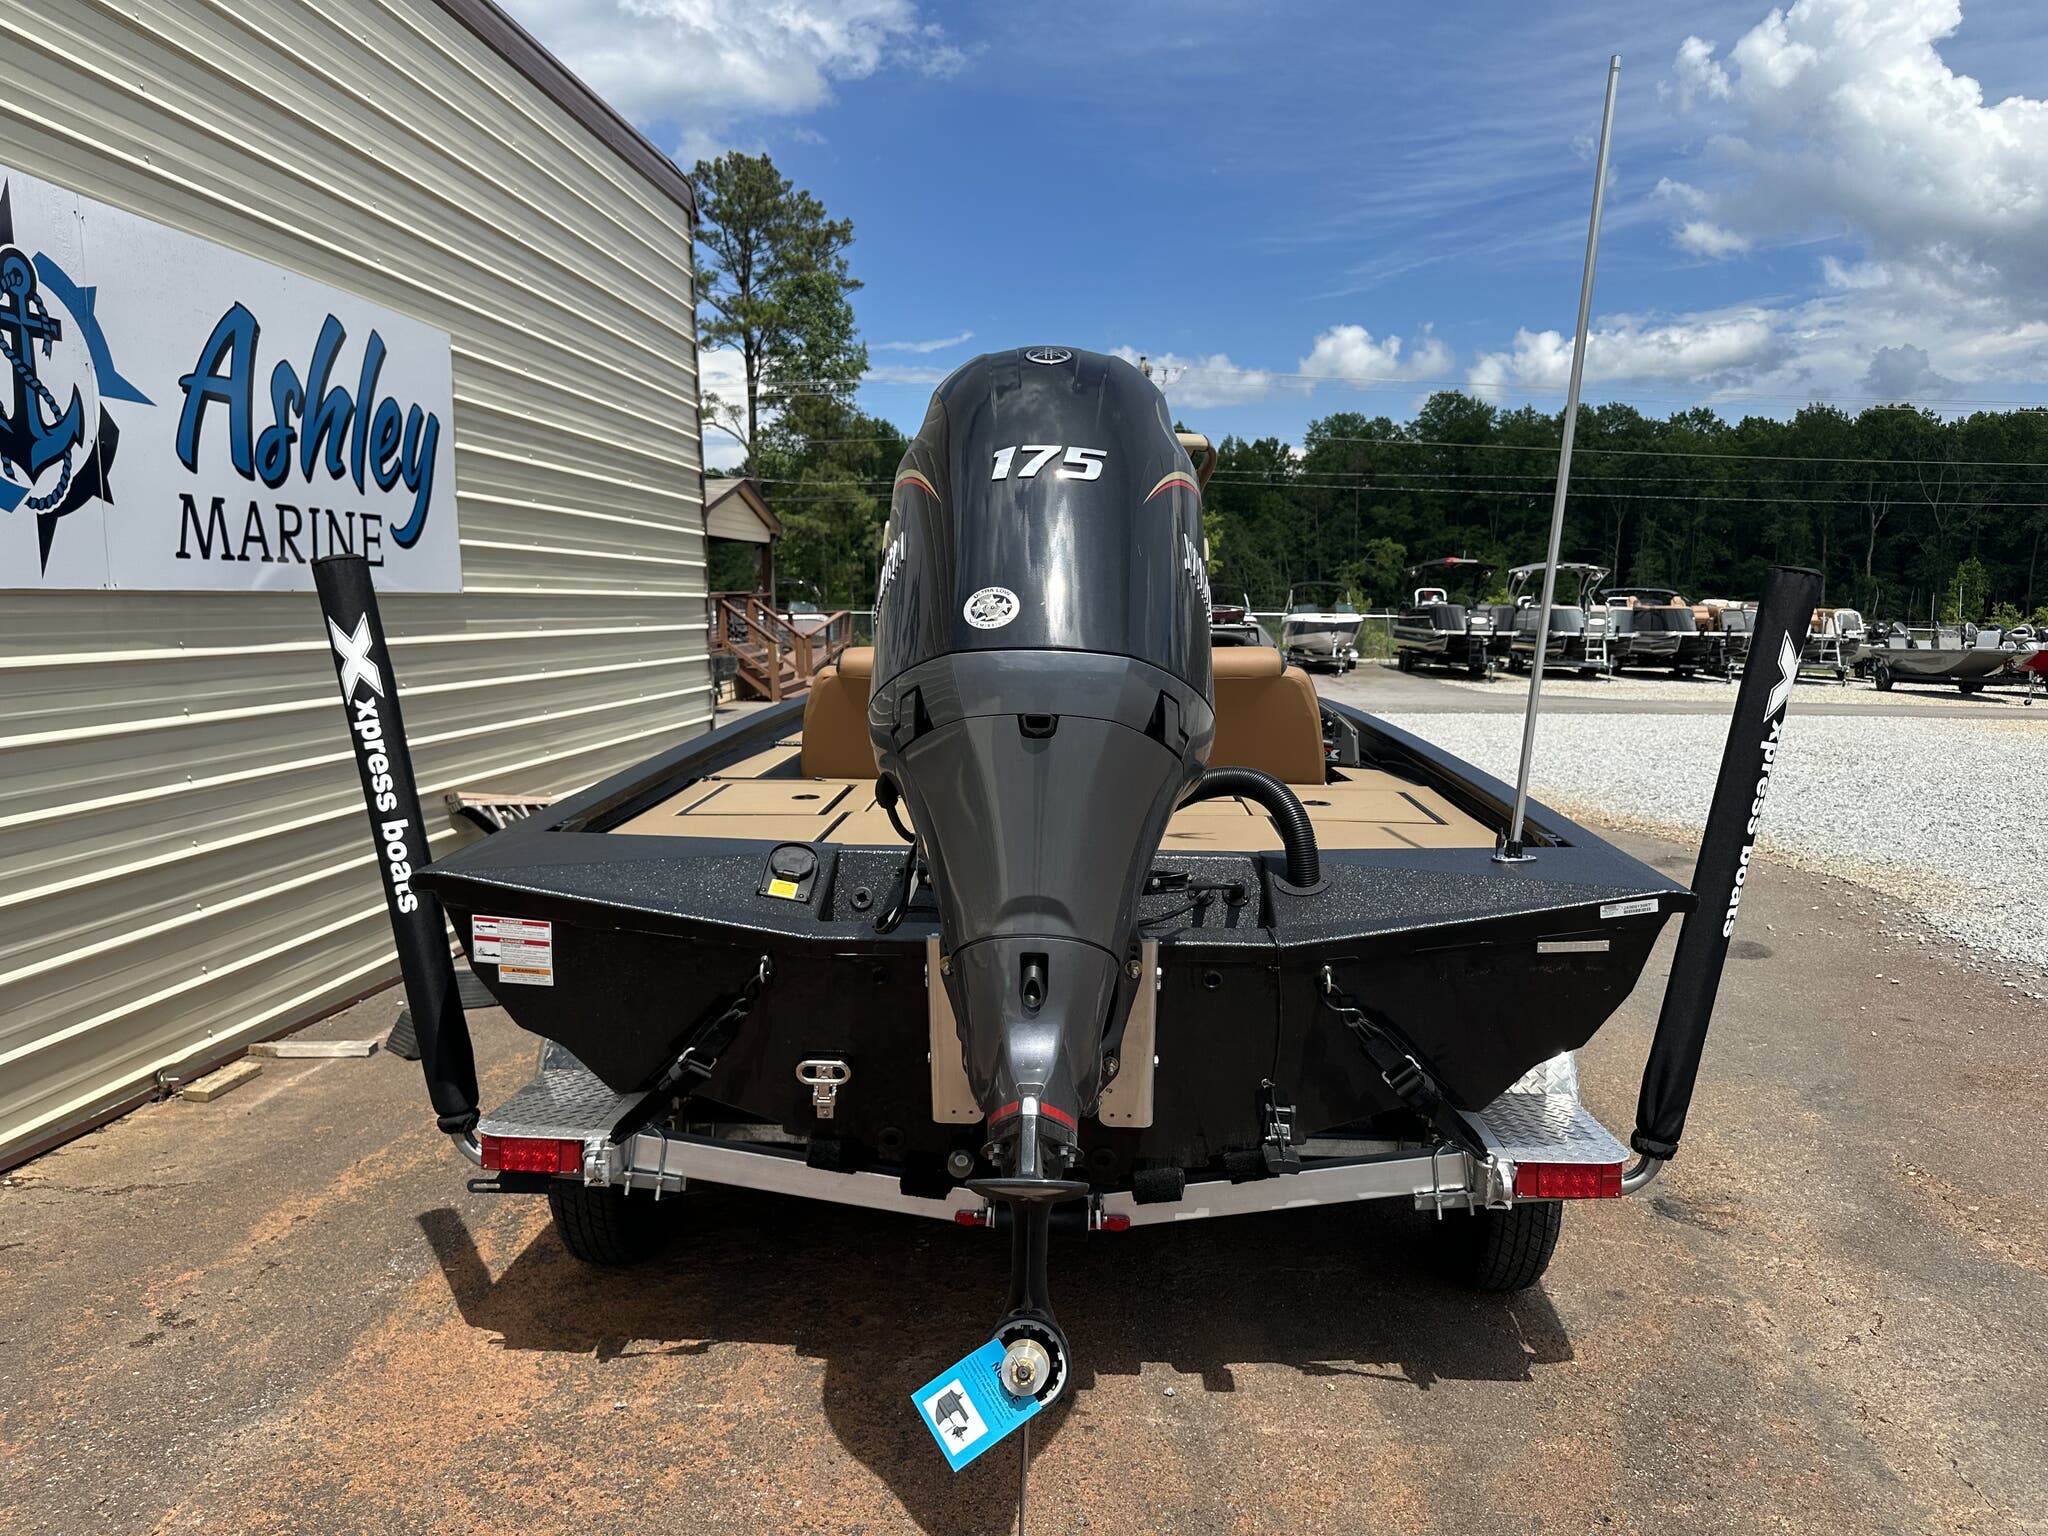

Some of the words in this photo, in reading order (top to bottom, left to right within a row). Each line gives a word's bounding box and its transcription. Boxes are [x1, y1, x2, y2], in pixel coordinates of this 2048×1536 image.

[176, 301, 439, 549] Ashley
[992, 445, 1108, 482] 175
[176, 493, 384, 567] MARINE
[973, 588, 994, 599] ULTRA
[996, 588, 1012, 596] LOW
[354, 697, 398, 814] xpress
